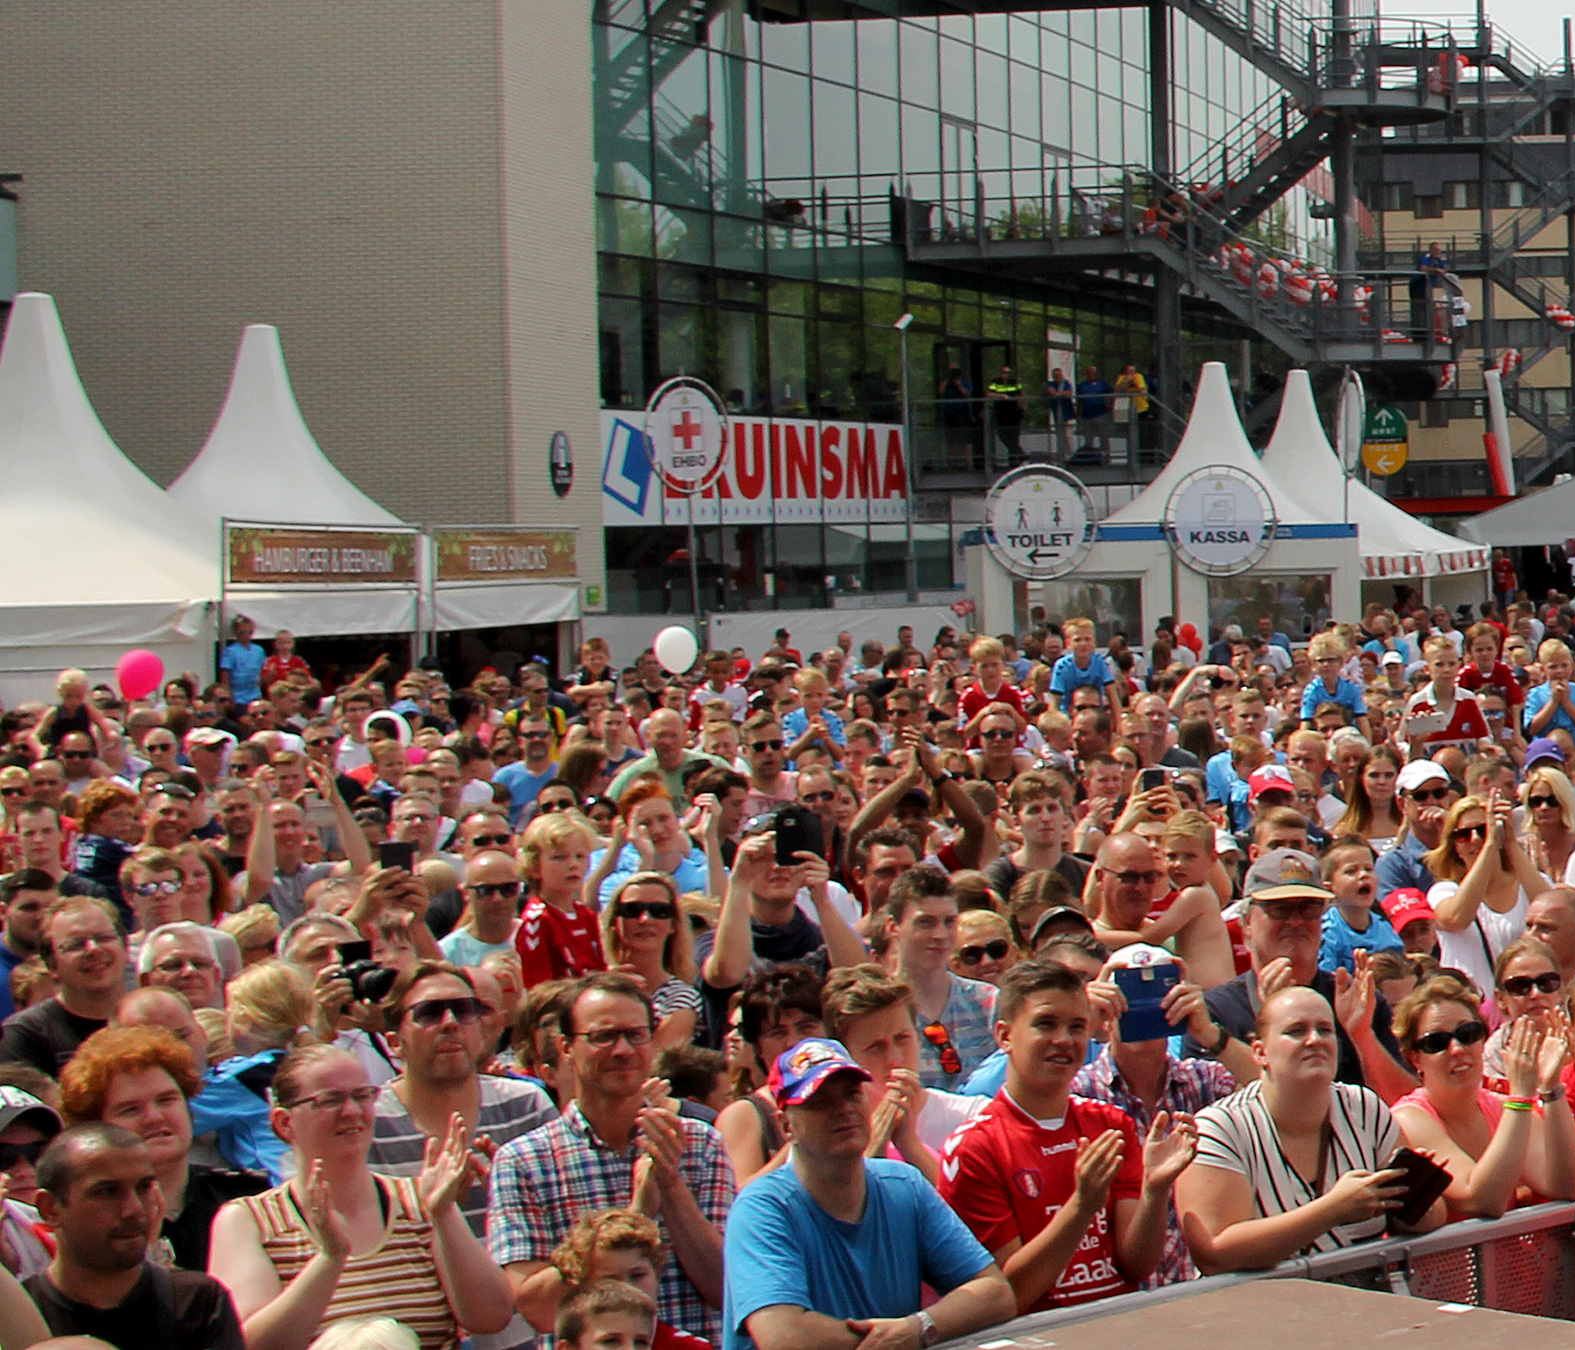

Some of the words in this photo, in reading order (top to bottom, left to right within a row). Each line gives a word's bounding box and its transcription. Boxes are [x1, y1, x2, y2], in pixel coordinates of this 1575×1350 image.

[663, 421, 907, 500] UINSMA
[672, 455, 707, 469] EHBO
[1007, 532, 1074, 548] TOILET
[1190, 530, 1250, 545] KASSA
[252, 547, 331, 573] HAMBURGER
[468, 545, 499, 571] FRIES
[508, 545, 548, 570] SNACKS
